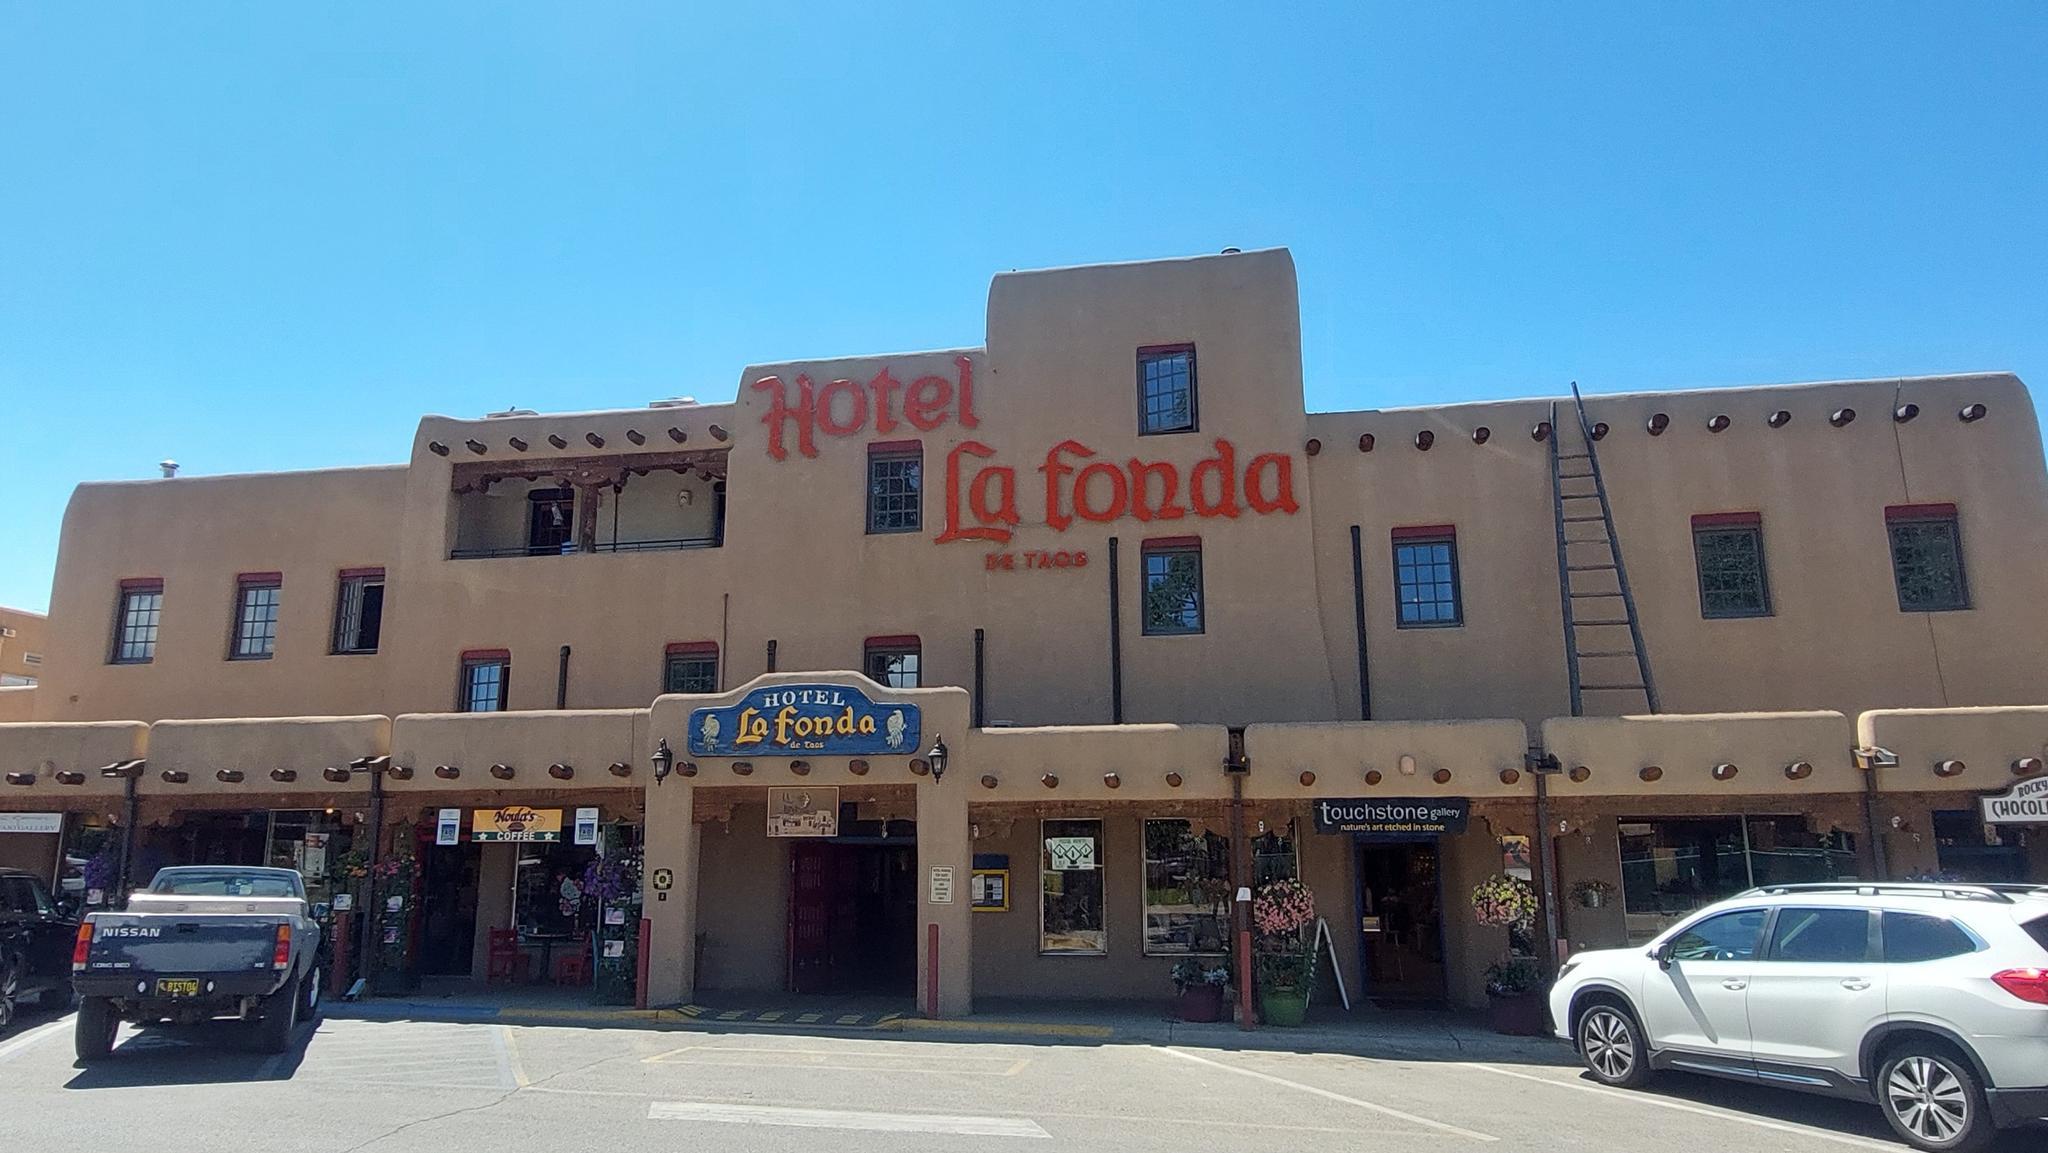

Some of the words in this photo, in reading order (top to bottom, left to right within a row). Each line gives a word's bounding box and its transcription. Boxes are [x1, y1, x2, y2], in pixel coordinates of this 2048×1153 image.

[751, 356, 980, 461] Hotel
[934, 440, 1021, 544] La
[985, 552, 1015, 571] DE
[1023, 549, 1089, 570] TAOS
[763, 689, 846, 708] HOTEL
[735, 706, 770, 744] La
[789, 741, 801, 749] de
[804, 741, 825, 749] Taos
[2017, 780, 2048, 799] ROCKY
[1319, 801, 1429, 825] touchstone
[1430, 807, 1461, 821] gallery
[1991, 800, 2048, 819] CHOCOL
[496, 831, 536, 841] COFFEE
[1340, 823, 1372, 831] nature's
[1384, 823, 1412, 831] etched
[1413, 823, 1421, 831] in
[1422, 823, 1446, 831] stone
[102, 928, 161, 938] NISSAN
